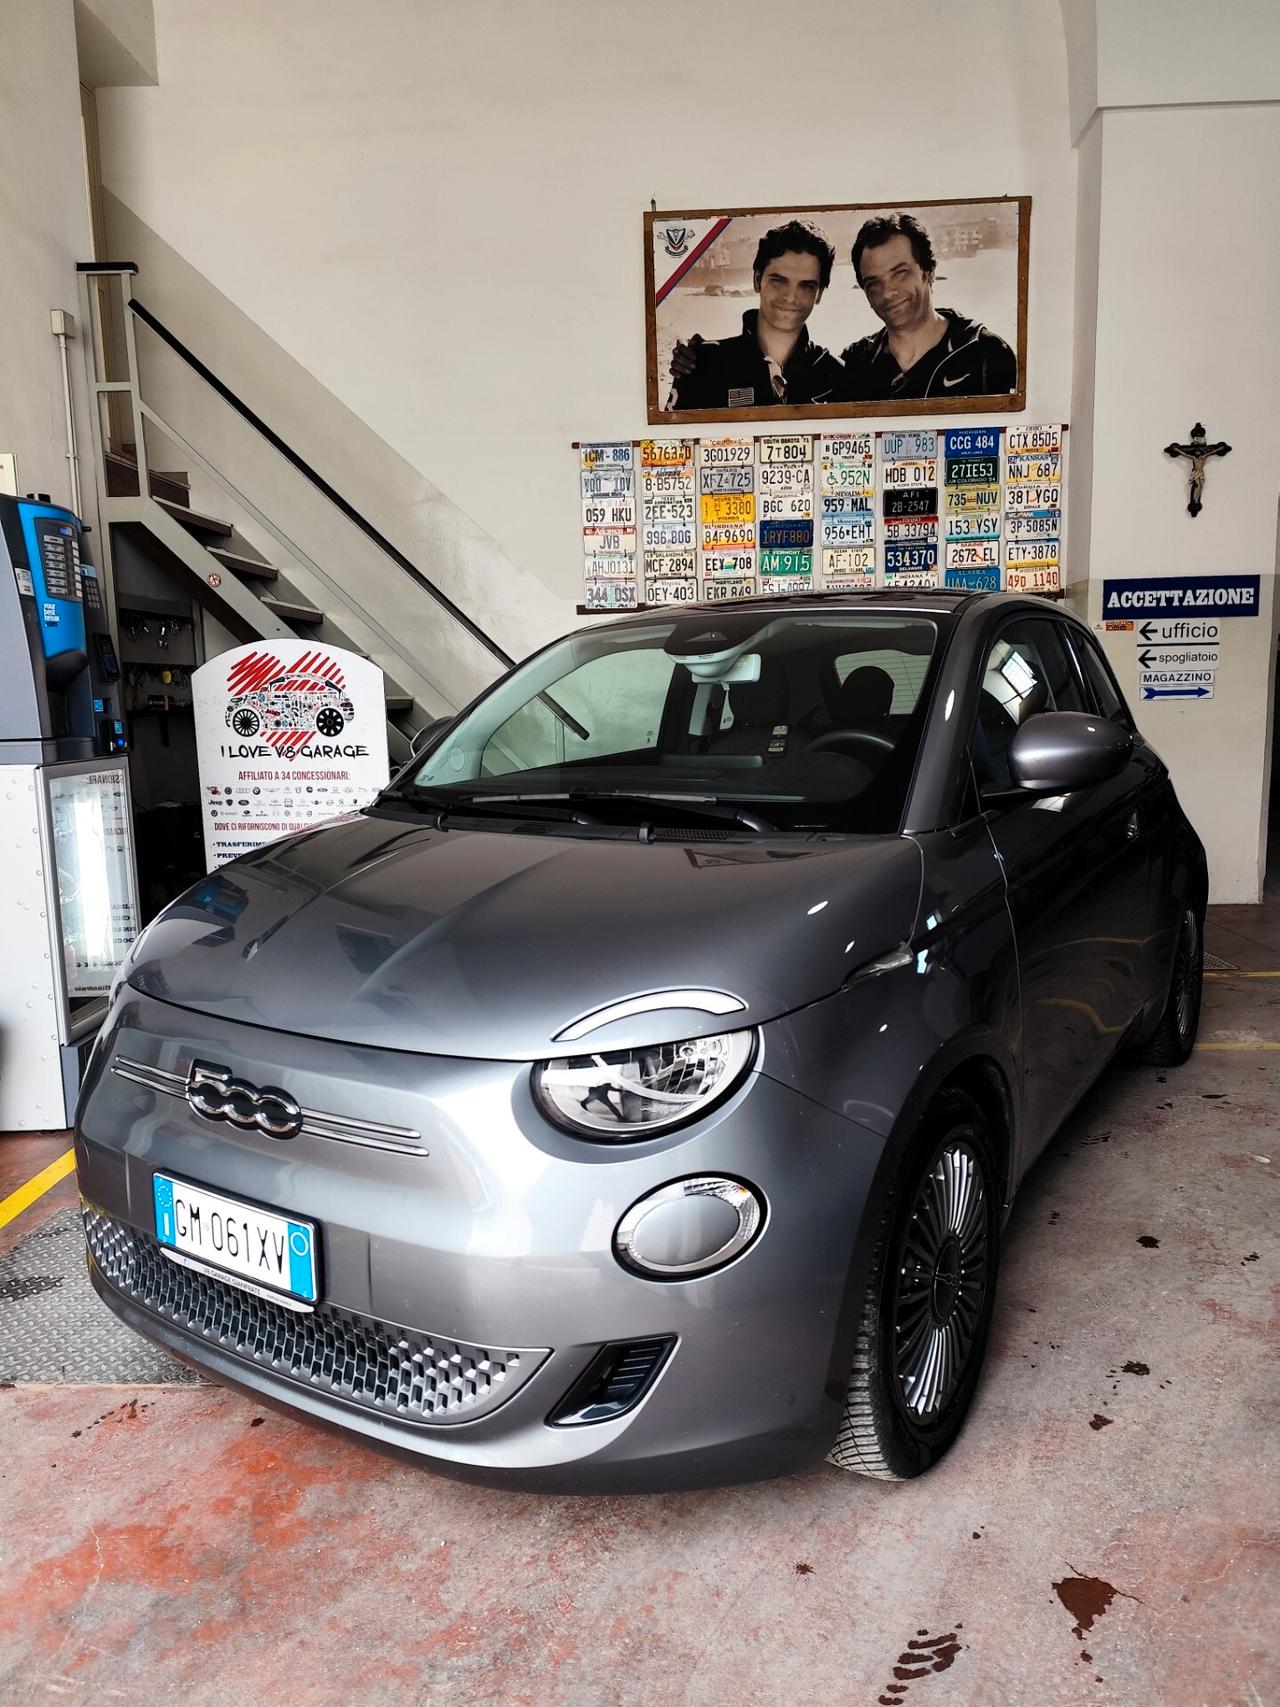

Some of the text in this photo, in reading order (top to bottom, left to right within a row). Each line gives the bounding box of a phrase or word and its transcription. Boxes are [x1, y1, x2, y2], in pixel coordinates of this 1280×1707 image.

[915, 437, 934, 453] 983
[950, 435, 994, 450] CCG 484
[1009, 432, 1058, 449] CTX 8505
[885, 466, 935, 483] HDB 012
[1009, 462, 1058, 479] NNJ 687
[948, 492, 998, 507] 735 NUV
[1008, 490, 1029, 505] 381
[763, 499, 811, 513] BGC 620
[585, 507, 632, 523] 059 HKU
[824, 526, 845, 540] 956
[887, 522, 936, 538] 5B 33794
[949, 518, 998, 535] 153 YSY
[599, 535, 620, 549] JVB
[887, 550, 934, 567] 534370
[952, 547, 996, 563] 2672 EL
[732, 557, 752, 570] 708
[975, 576, 996, 590] 628
[1107, 588, 1254, 608] ACCETTAZIONE
[1162, 622, 1218, 639] ufficio
[1158, 651, 1218, 664] spogliatoio
[1143, 672, 1211, 683] MAGAZZINO
[221, 745, 225, 757] I
[229, 745, 272, 758] LOVE
[300, 745, 370, 759] GARAGE
[238, 771, 351, 781] AFFILIATO A CONCESSIONARI:
[214, 823, 230, 831] DOVE
[238, 823, 280, 831] RIFORNISCONO
[187, 1058, 301, 1140] 500
[175, 1199, 202, 1245] GM
[211, 1212, 284, 1275] 061XV
